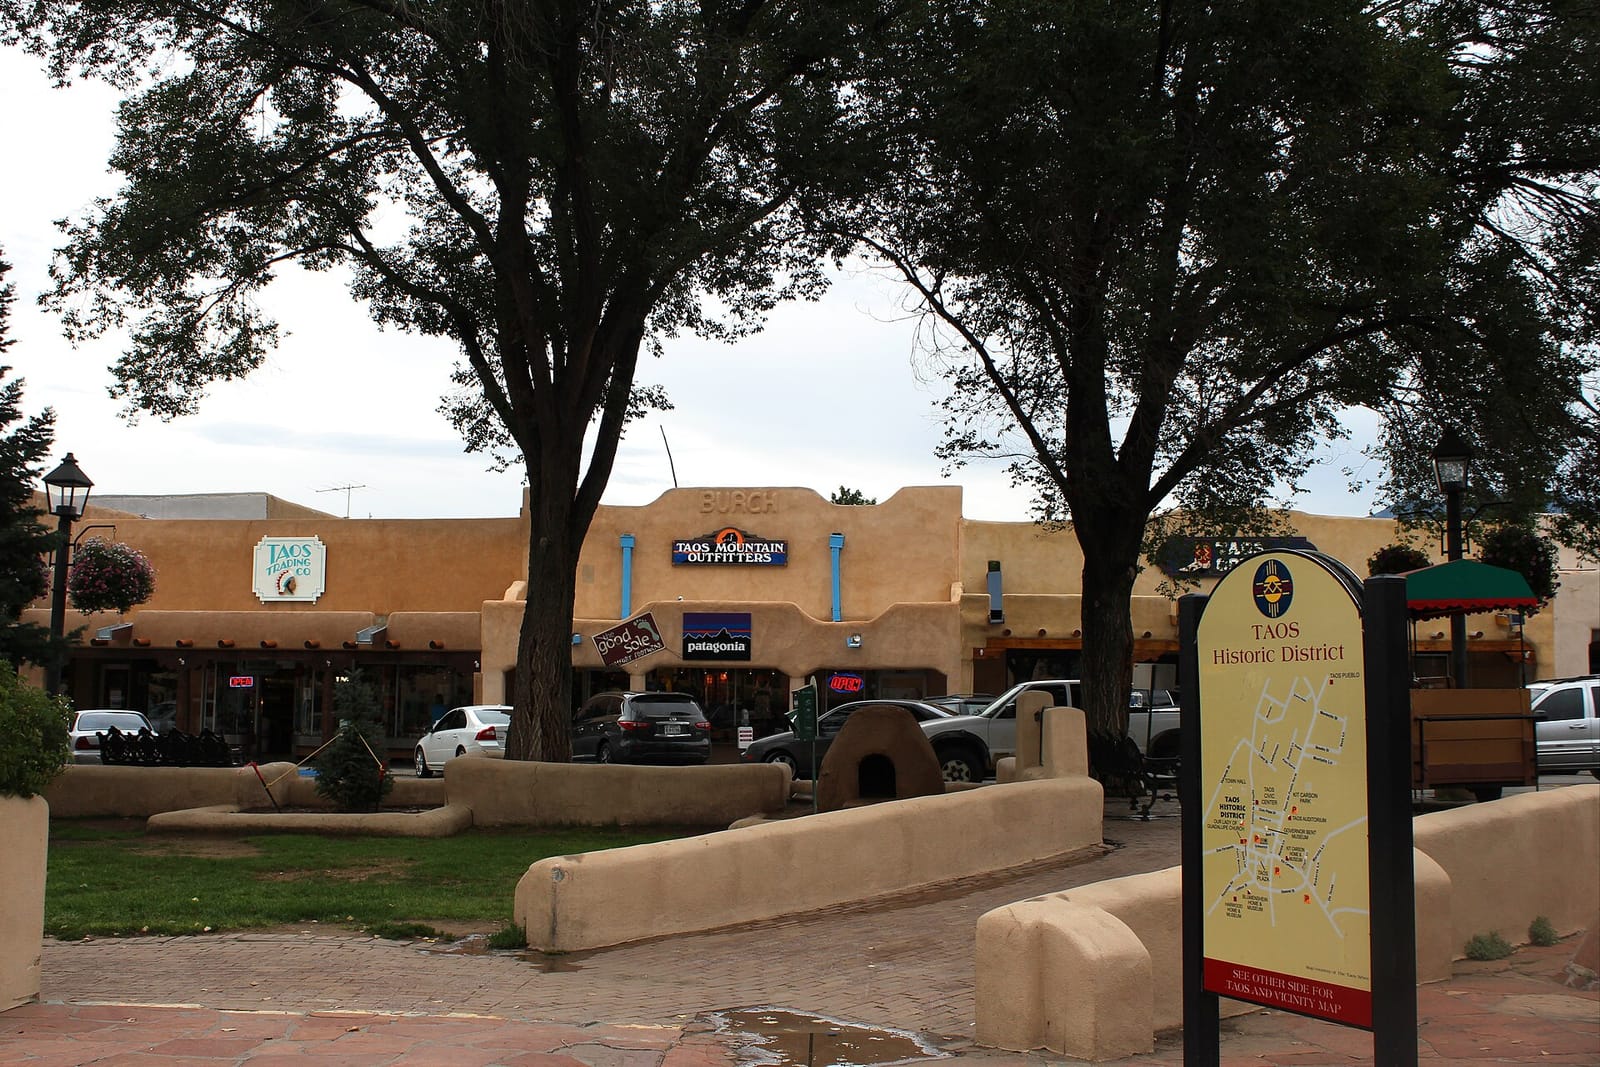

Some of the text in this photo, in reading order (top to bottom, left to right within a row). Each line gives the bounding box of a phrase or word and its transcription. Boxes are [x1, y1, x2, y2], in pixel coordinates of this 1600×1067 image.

[700, 490, 777, 514] BURCH
[266, 544, 312, 564] TAOS
[676, 542, 784, 552] TAOS MOUNTAIN
[266, 558, 311, 576] TRADING
[688, 553, 772, 562] OUTFITTERS
[1252, 622, 1300, 640] TAOS
[598, 628, 632, 656] good
[624, 635, 650, 654] sole
[688, 642, 746, 653] patagonia
[1214, 644, 1344, 664] Historic District
[830, 676, 862, 692] OPEN
[1232, 969, 1334, 1000] SEE OTHER SIDE FOR
[1226, 980, 1342, 1014] TAOS AND VICINITY MAP
